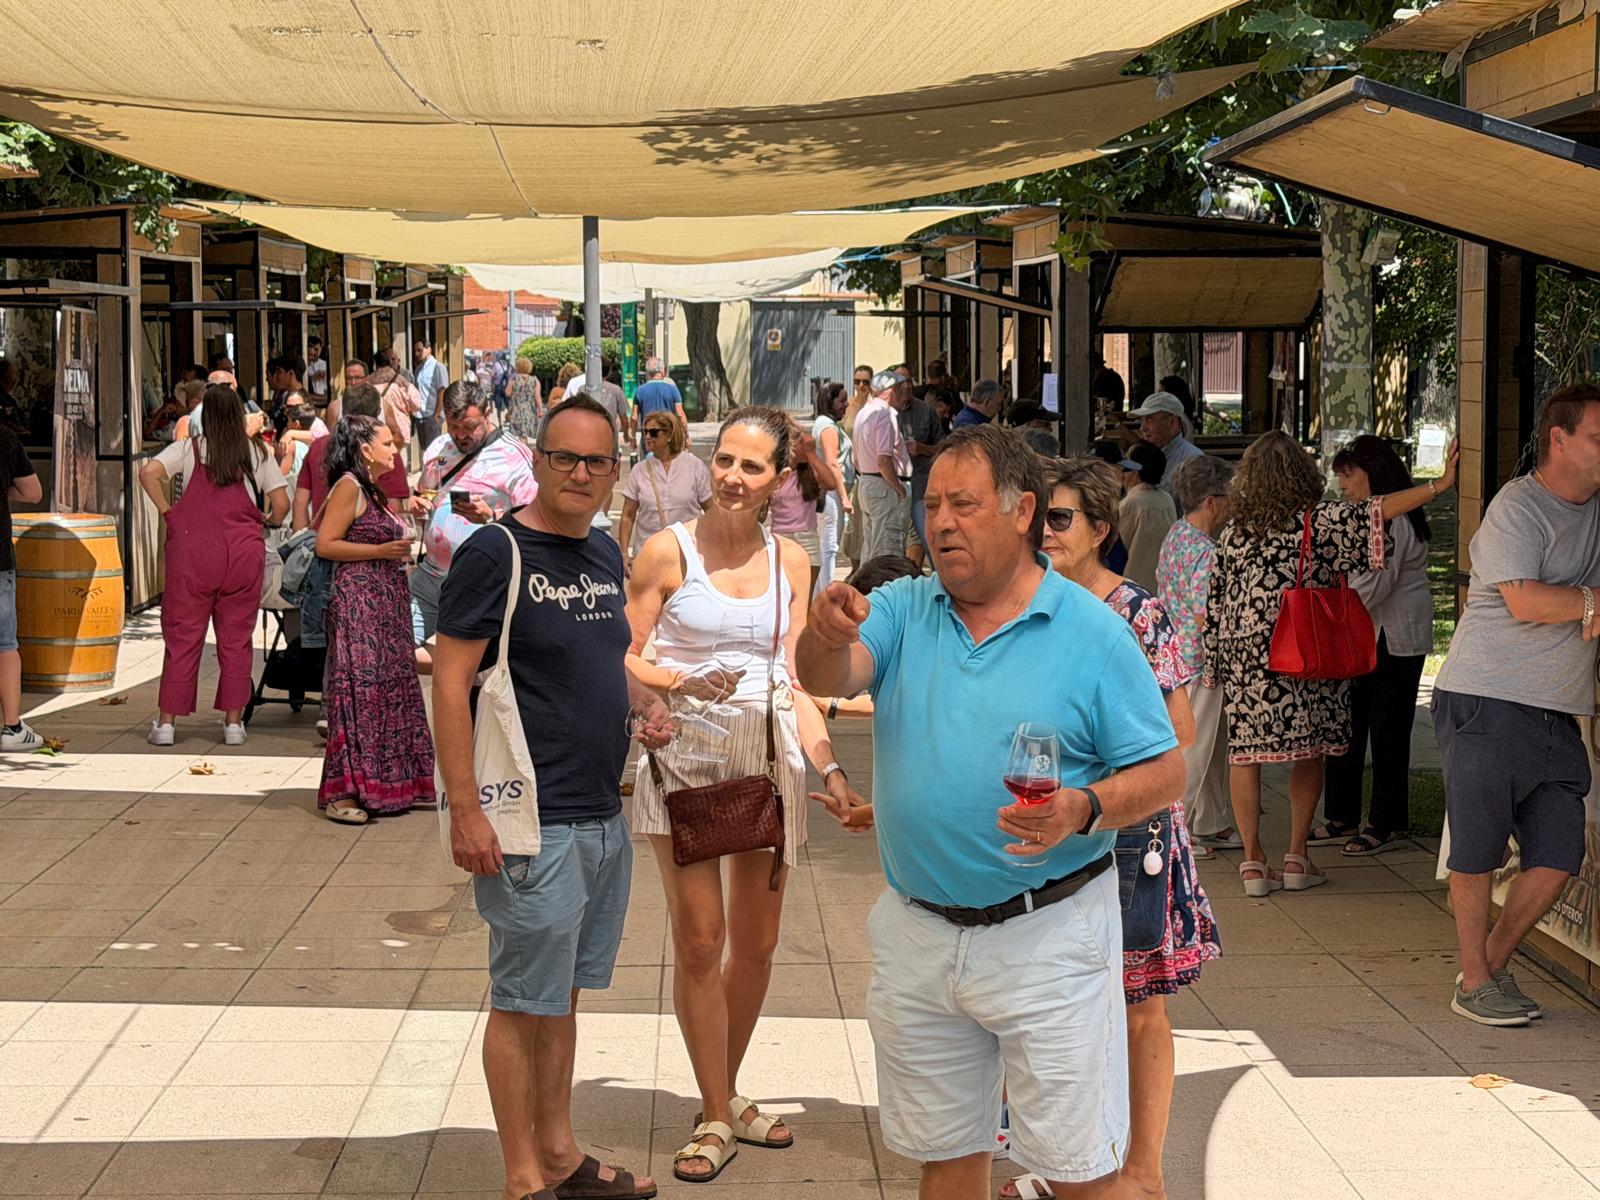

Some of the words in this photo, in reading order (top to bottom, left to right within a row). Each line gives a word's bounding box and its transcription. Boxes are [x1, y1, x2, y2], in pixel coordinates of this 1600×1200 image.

[528, 573, 582, 610] Pepe
[580, 573, 619, 610] Jeans
[575, 611, 613, 622] LONDON
